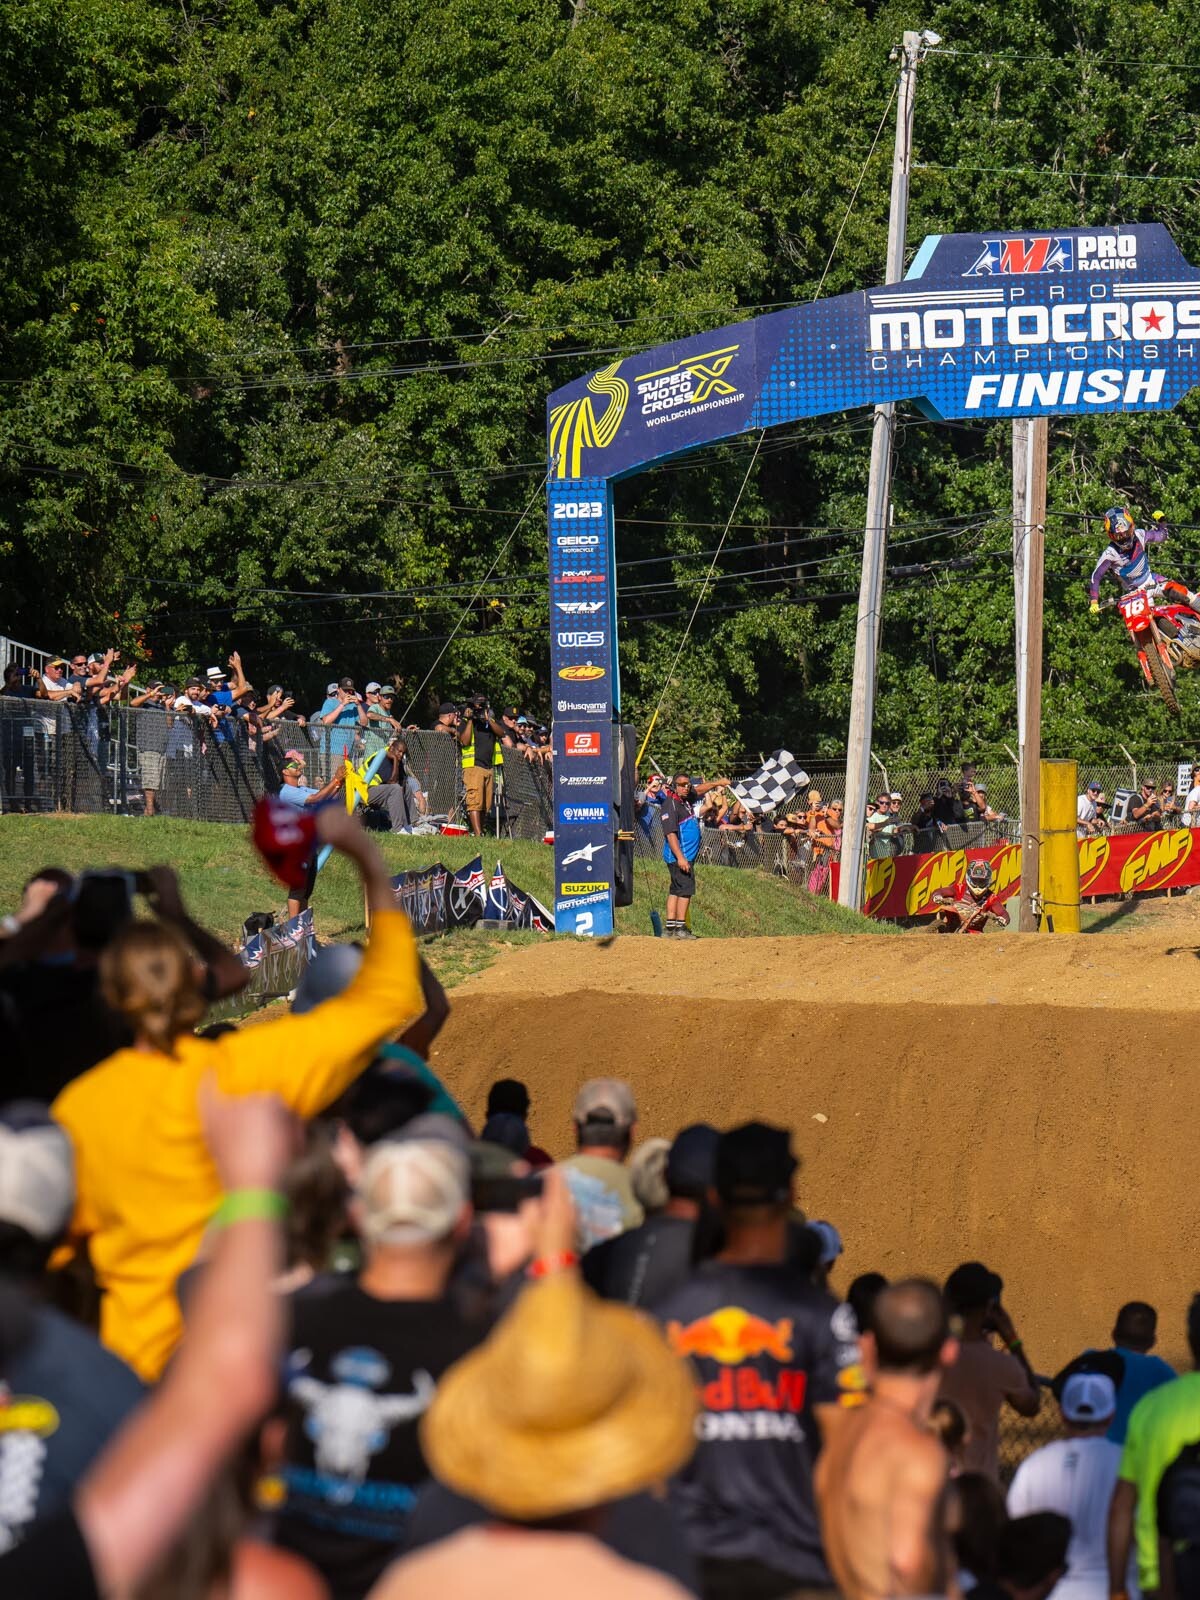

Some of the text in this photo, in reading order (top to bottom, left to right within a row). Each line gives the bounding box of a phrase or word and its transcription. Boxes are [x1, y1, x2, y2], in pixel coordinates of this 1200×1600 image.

[961, 237, 1073, 276] AMA
[1077, 235, 1137, 258] PRO
[1078, 258, 1137, 271] RACING
[1010, 284, 1107, 302] PRO
[638, 371, 692, 395] SUPER
[643, 381, 692, 404] MOTO
[965, 368, 1166, 409] FINISH
[641, 391, 694, 415] CROSS
[646, 393, 745, 428] WORLD CHAMPIONSHIP
[553, 502, 603, 519] 2023
[557, 535, 599, 546] GEICO
[558, 632, 605, 648] WPS
[567, 702, 607, 711] Husqvarna
[573, 808, 605, 817] YAMAHA
[1122, 828, 1190, 893] FMF
[565, 884, 606, 893] SUZUKI
[557, 893, 609, 911] MOTOCROSS
[576, 911, 594, 937] 2
